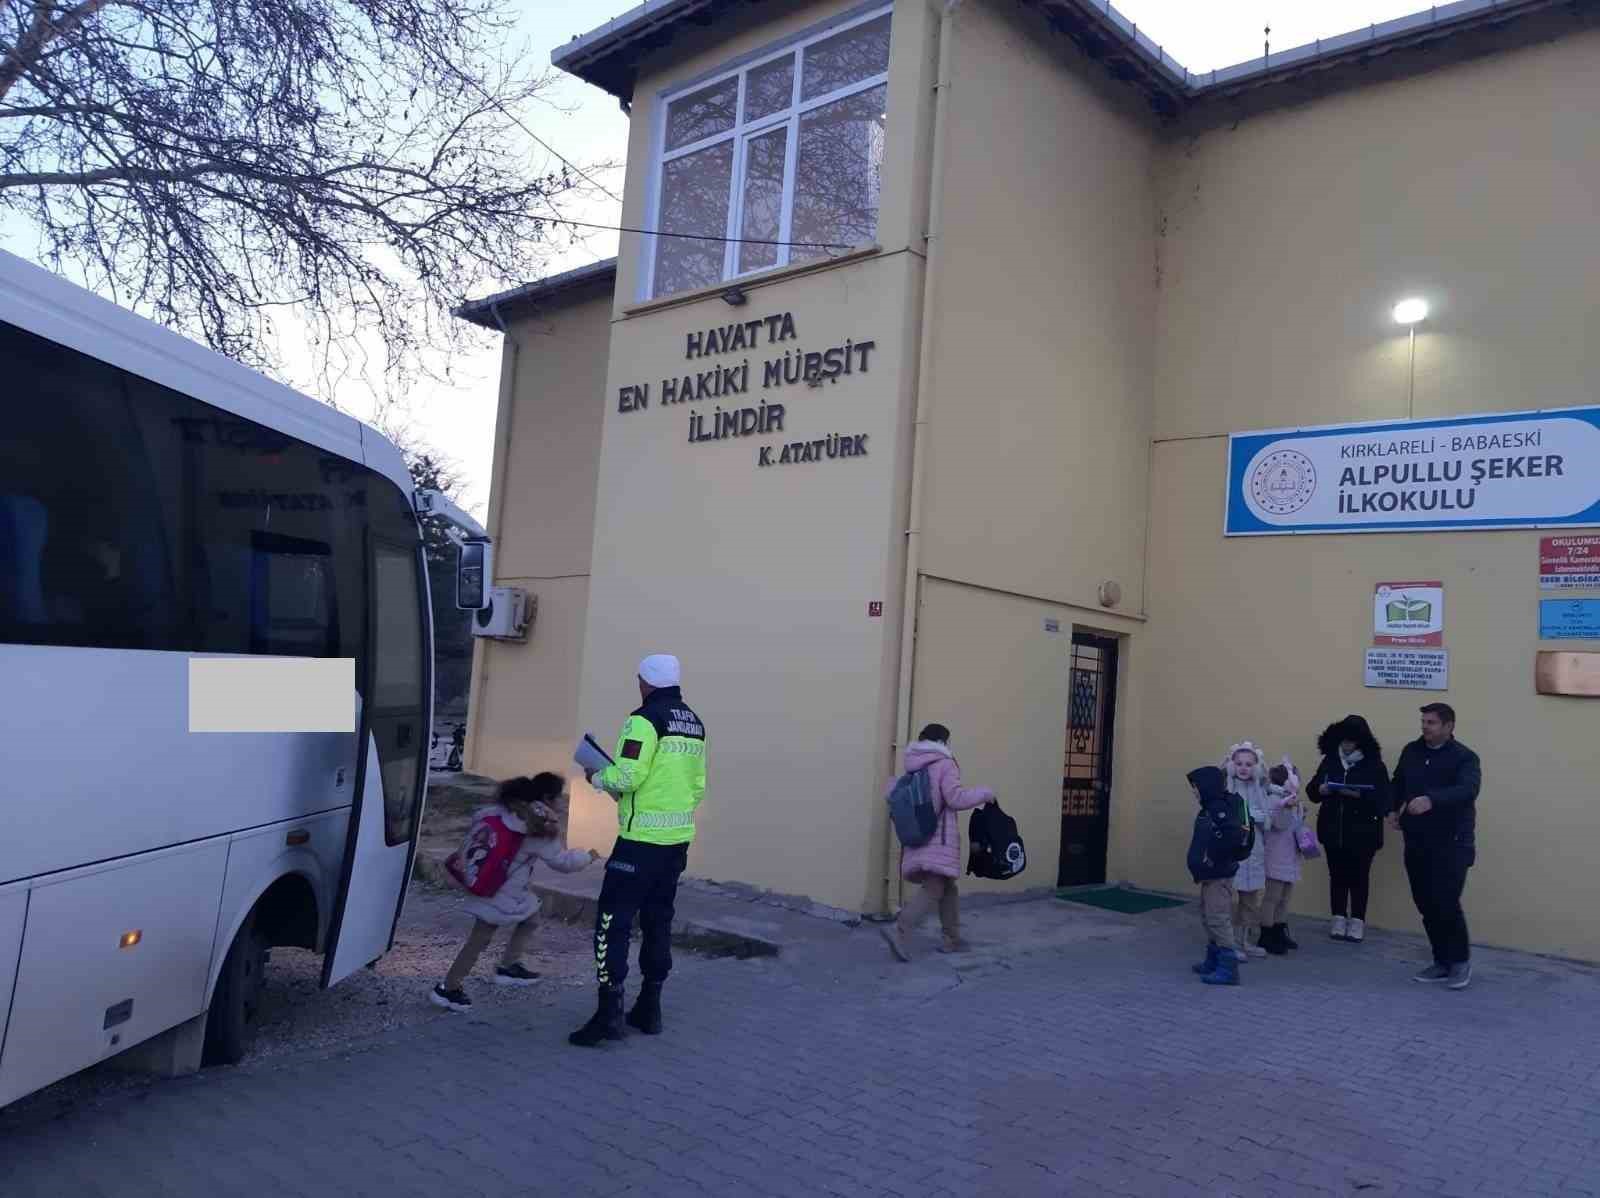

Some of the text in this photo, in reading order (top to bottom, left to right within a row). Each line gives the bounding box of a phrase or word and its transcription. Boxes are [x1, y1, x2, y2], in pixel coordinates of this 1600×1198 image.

[685, 312, 797, 359] HAYATTA
[618, 338, 875, 413] EN HAKİKİ MÜRŞİT
[687, 399, 786, 443] İLİMDİR
[1340, 439, 1435, 458] KIRKLARELİ
[1451, 428, 1542, 452] BABAESKİ
[1339, 454, 1564, 487] ALPULLU ŞEKER
[1338, 488, 1476, 514] İLKOKULU
[1567, 547, 1589, 556] 7/24
